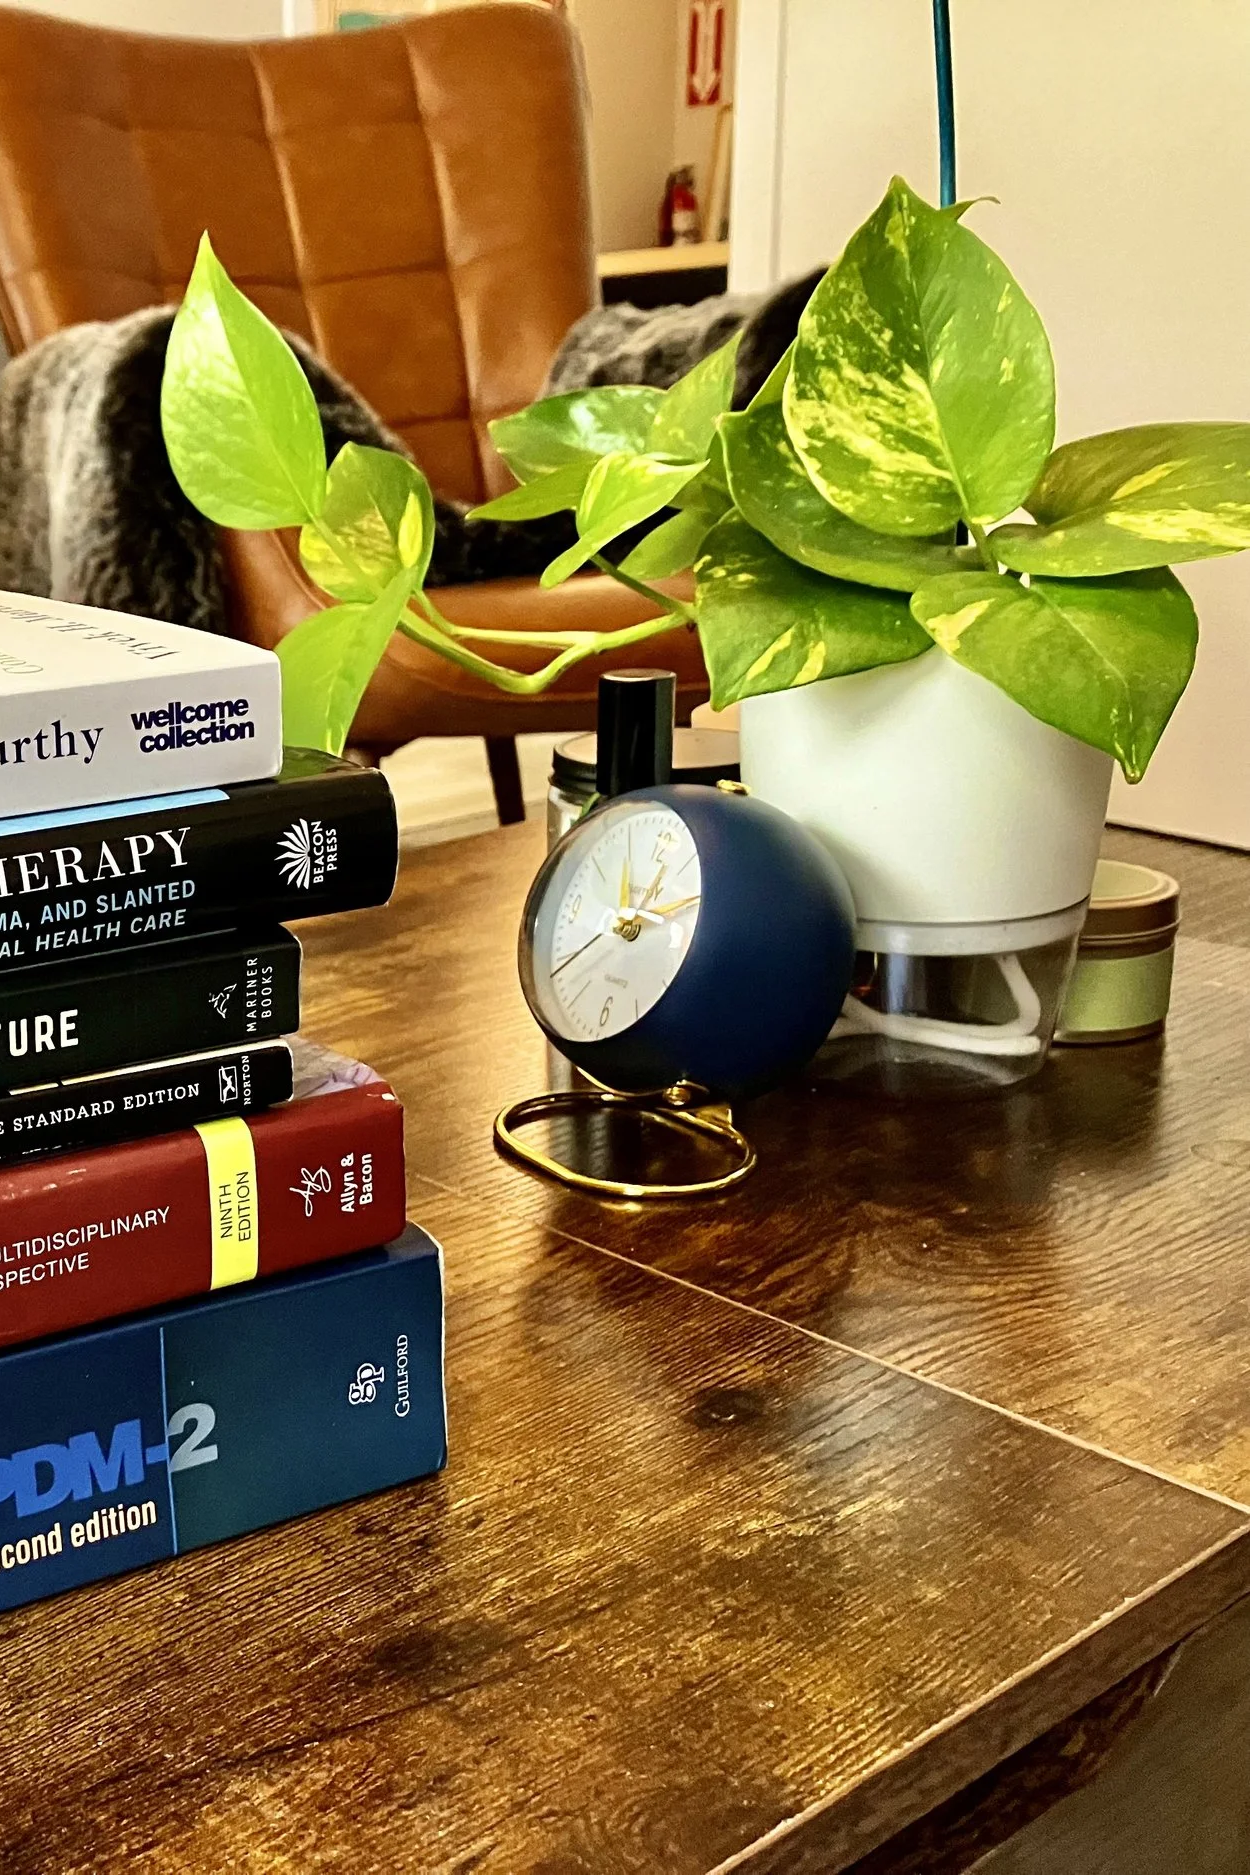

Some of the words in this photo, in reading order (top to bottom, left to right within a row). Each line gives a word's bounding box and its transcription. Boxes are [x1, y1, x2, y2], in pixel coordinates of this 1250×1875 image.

[83, 631, 181, 660] Vivek
[130, 698, 249, 730] wellcome
[139, 718, 255, 754] collection
[313, 820, 323, 884] BEACON
[327, 828, 337, 871] PRESS
[40, 900, 87, 924] AND
[97, 879, 196, 913] SLANTED
[35, 922, 121, 952] HEALTH
[130, 909, 187, 933] CARE
[246, 957, 257, 1032] MARINER
[261, 965, 273, 1018] BOOKS
[599, 996, 613, 1027] 6
[244, 1055, 252, 1105] NORTON
[13, 1100, 115, 1130] STANDARD
[123, 1083, 200, 1112] EDITION
[341, 1153, 354, 1169] &
[360, 1153, 372, 1204] Bacon
[219, 1183, 234, 1239] NINTH
[238, 1170, 251, 1242] EDITION
[341, 1173, 356, 1212] Allyn
[395, 1334, 408, 1417] GUILFORD
[70, 1500, 156, 1544] edition
